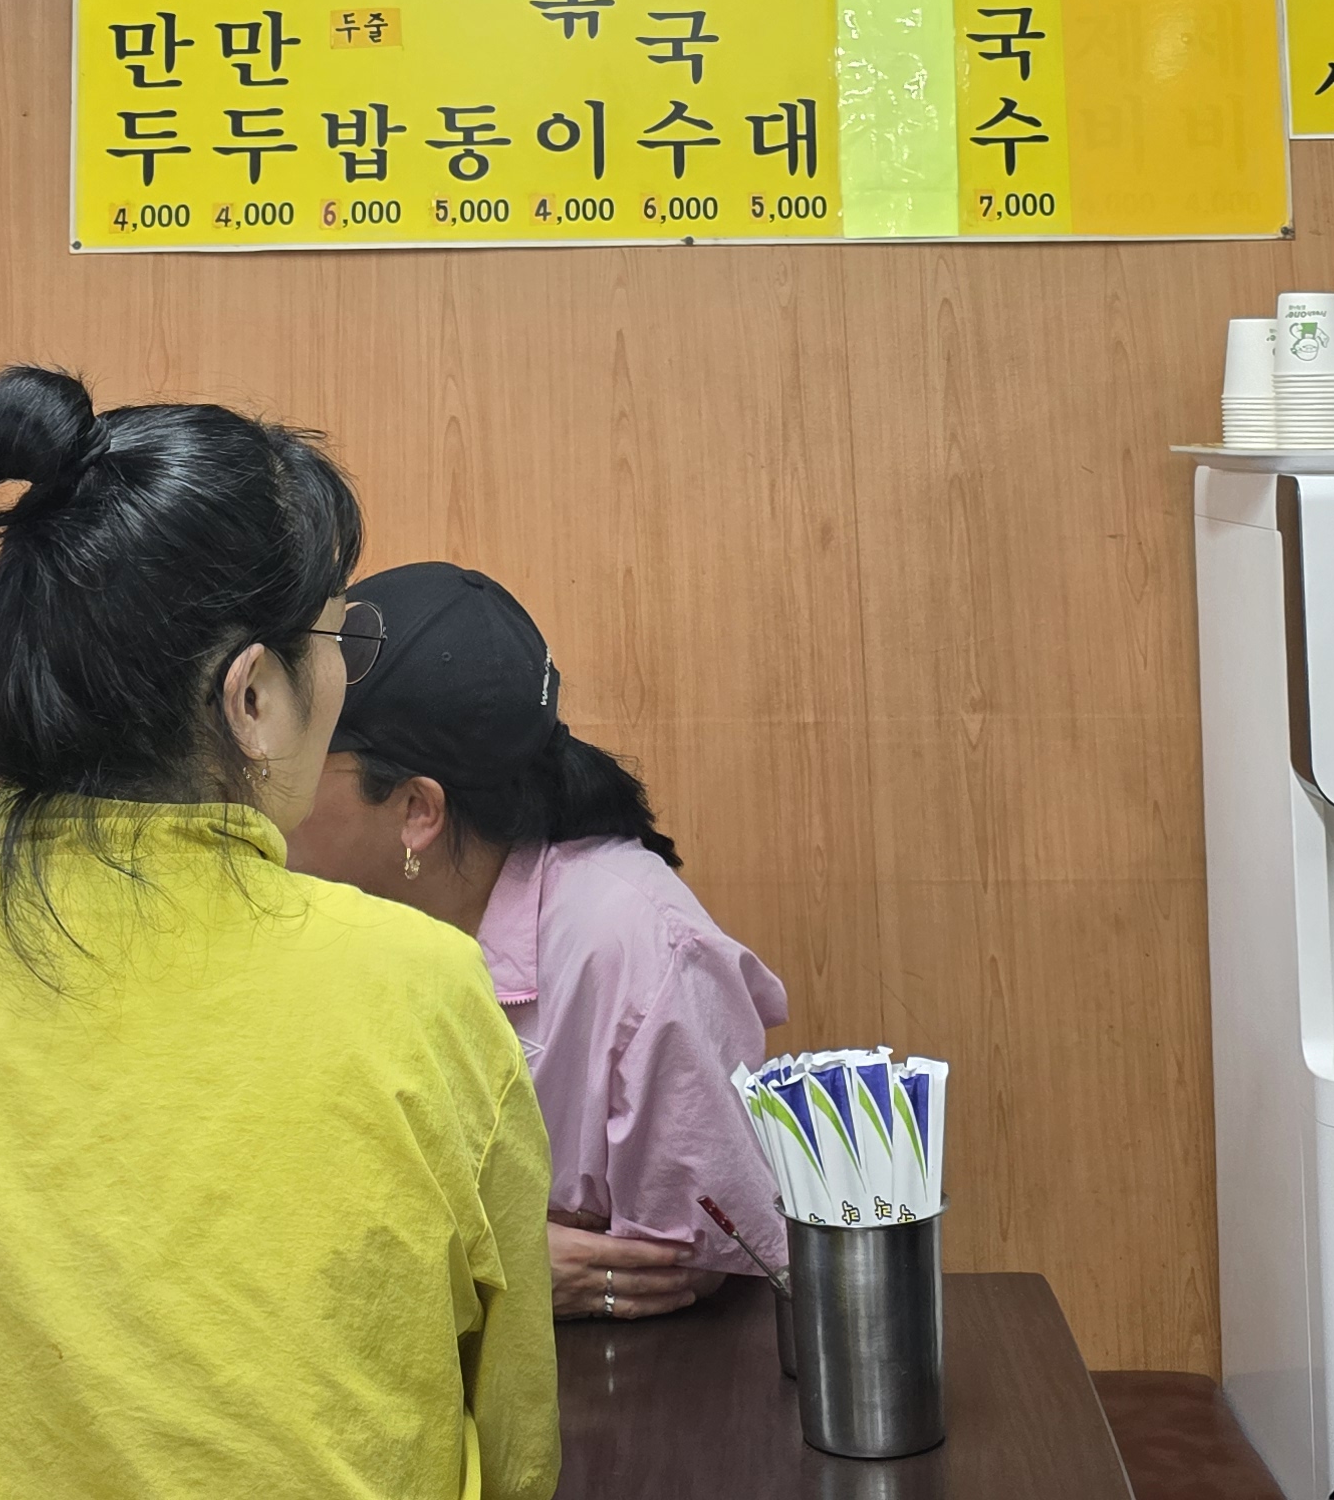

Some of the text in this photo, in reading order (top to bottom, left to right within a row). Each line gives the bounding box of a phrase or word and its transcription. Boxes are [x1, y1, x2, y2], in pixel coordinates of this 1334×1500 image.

[335, 12, 388, 43] 두줄
[113, 204, 190, 231] 4,000
[215, 202, 294, 228] 4,000
[323, 200, 401, 227] 6,000
[435, 199, 509, 226] 5,000
[535, 198, 615, 225] 4,000
[643, 196, 718, 223] 6,000
[751, 195, 827, 222] 5,000
[979, 193, 1055, 220] 7,000
